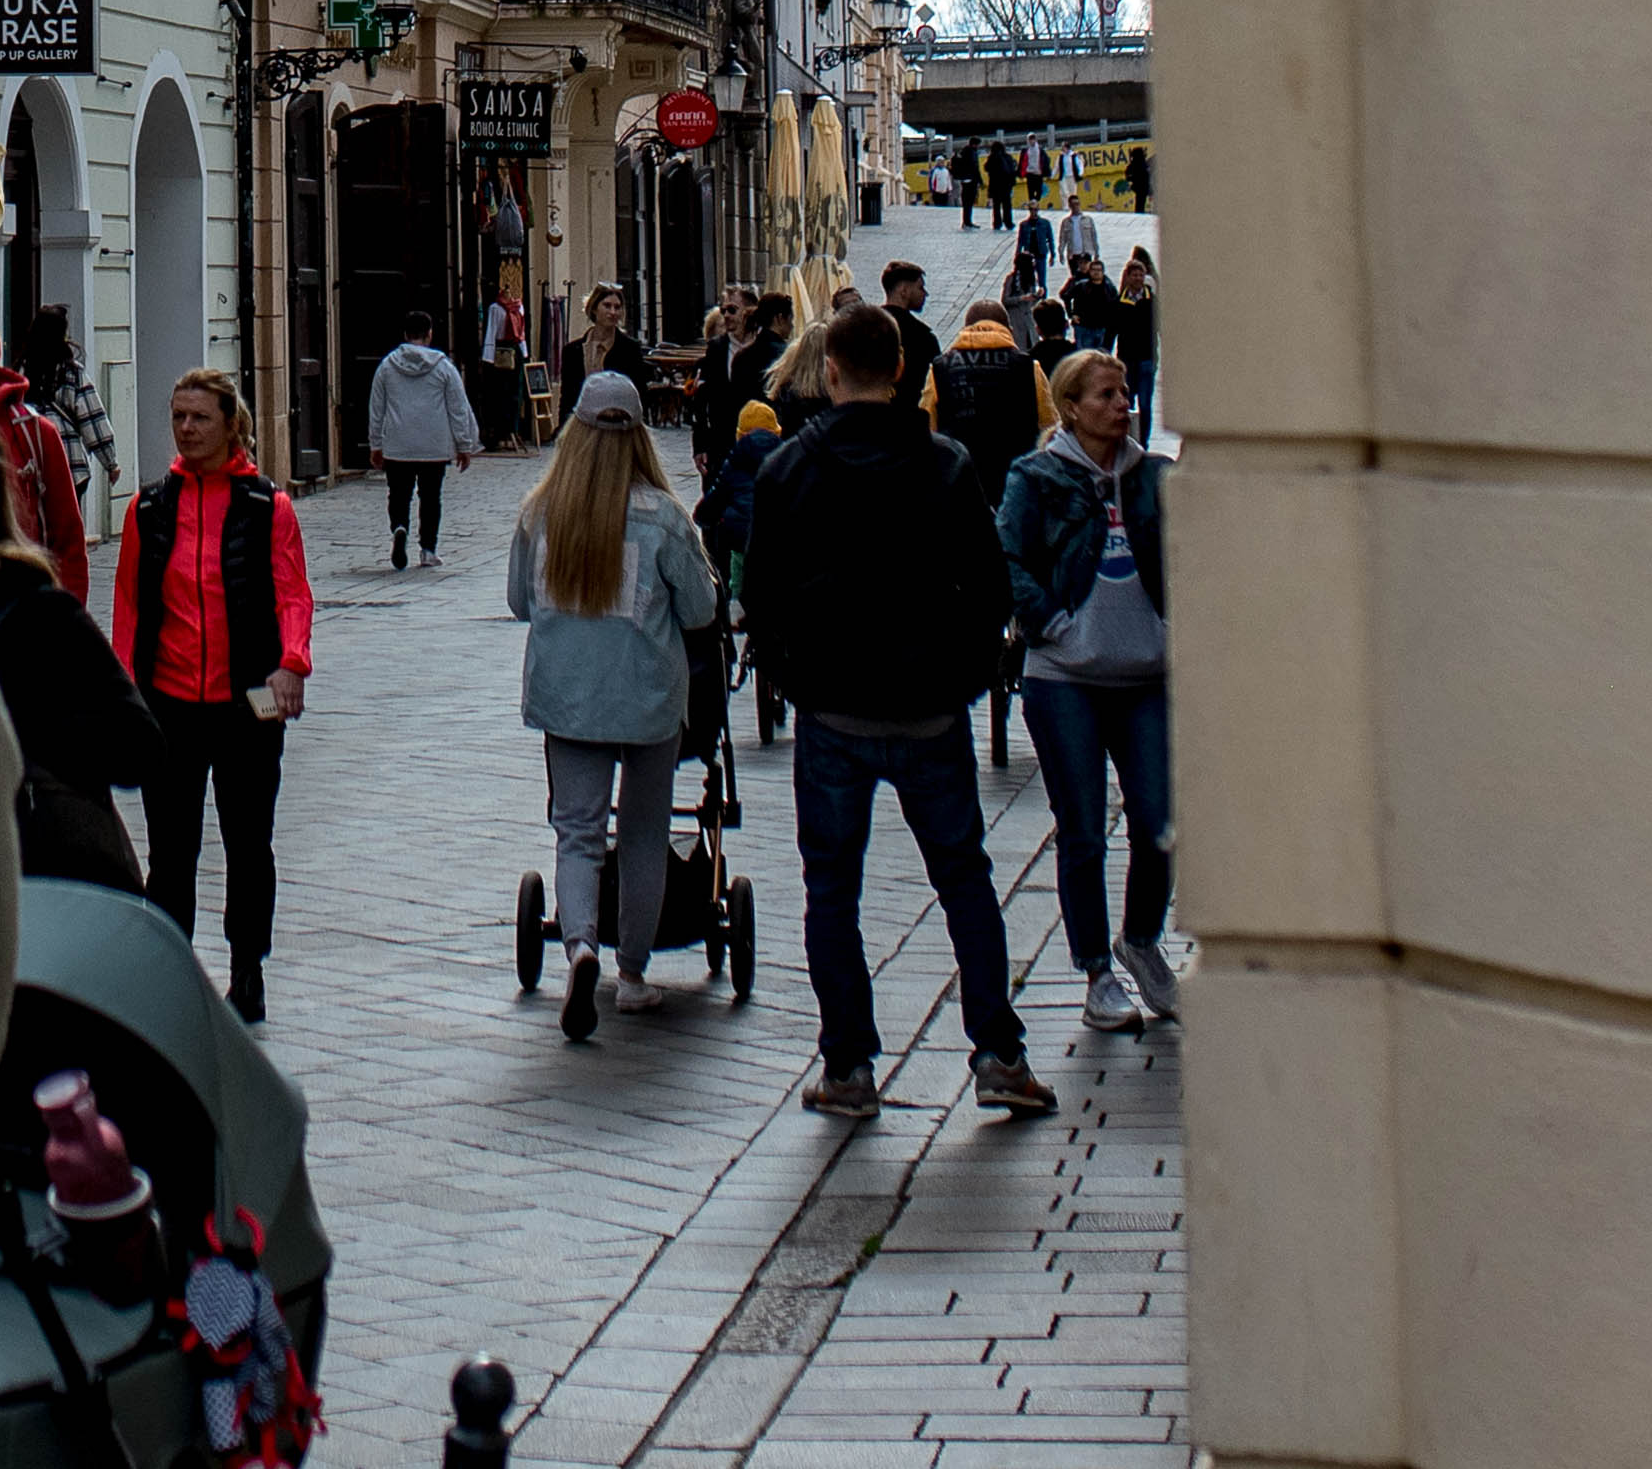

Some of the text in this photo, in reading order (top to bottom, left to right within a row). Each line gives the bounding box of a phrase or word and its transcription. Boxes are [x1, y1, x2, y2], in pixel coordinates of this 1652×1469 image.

[8, 50, 25, 61] UP
[27, 49, 78, 61] GALLERY
[469, 88, 543, 117] SAMSA
[470, 121, 540, 138] BOHO & ETHNIC
